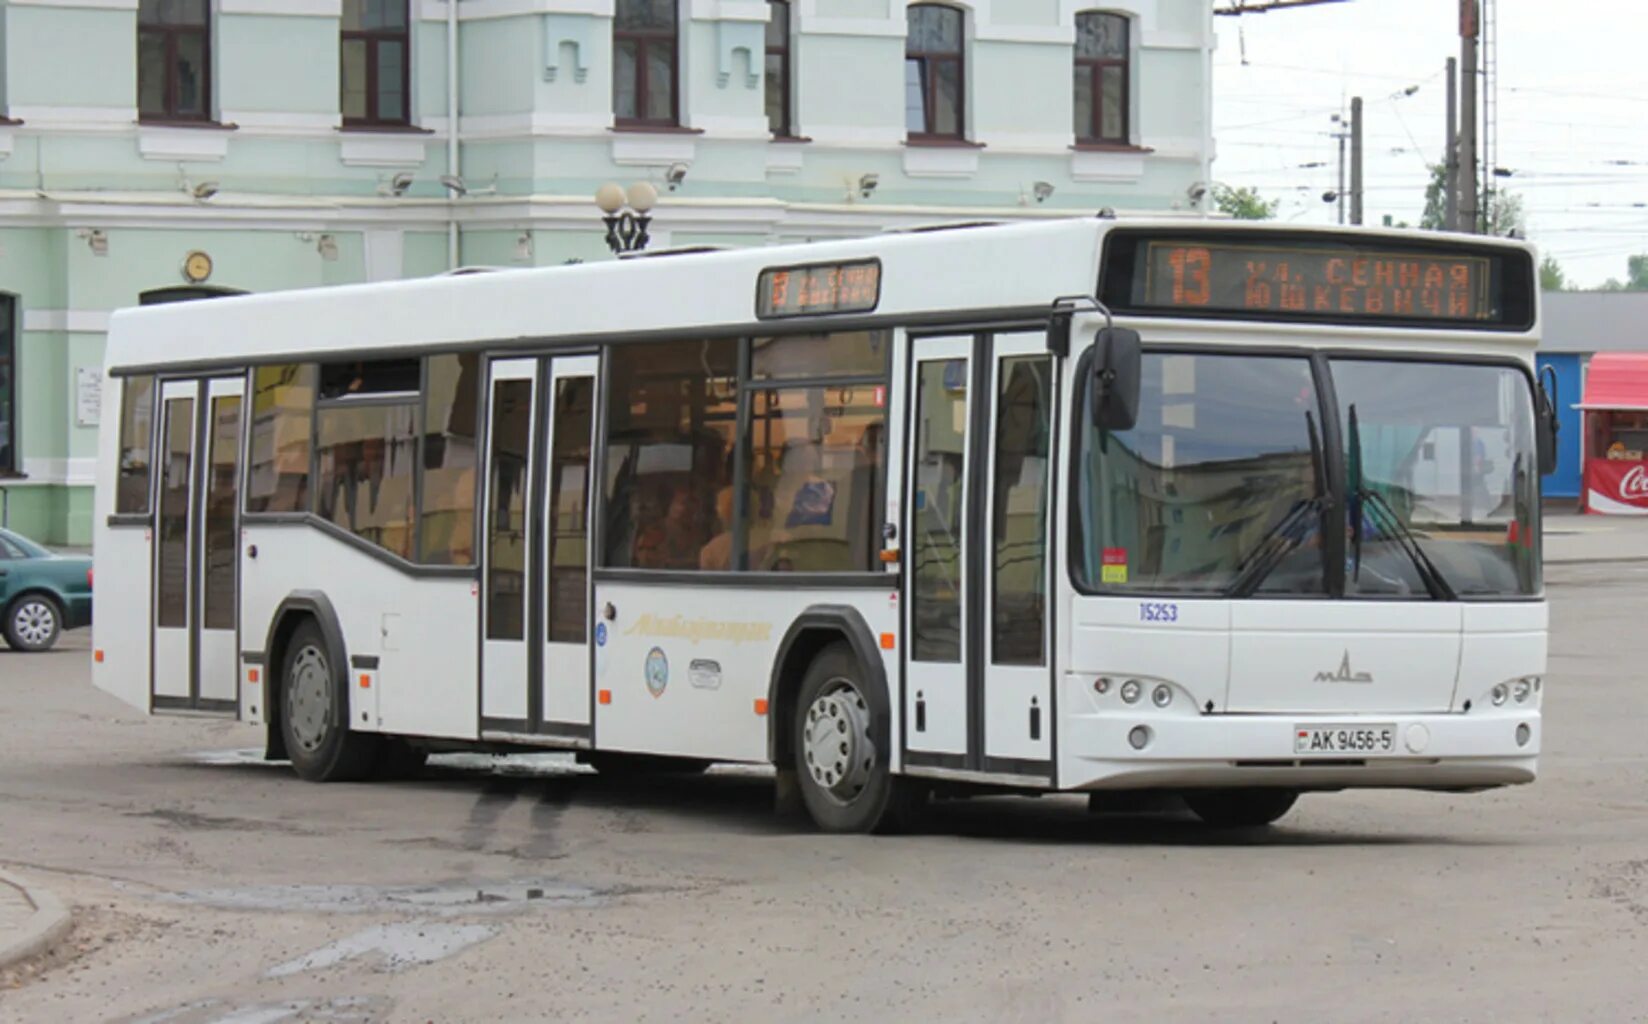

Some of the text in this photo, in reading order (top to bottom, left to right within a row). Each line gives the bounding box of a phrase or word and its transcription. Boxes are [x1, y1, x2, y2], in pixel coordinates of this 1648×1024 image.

[1169, 247, 1211, 304] 13
[1325, 258, 1469, 288] СЕННАЯ
[1140, 603, 1178, 621] 15253
[1311, 731, 1391, 750] AK 9456-5
